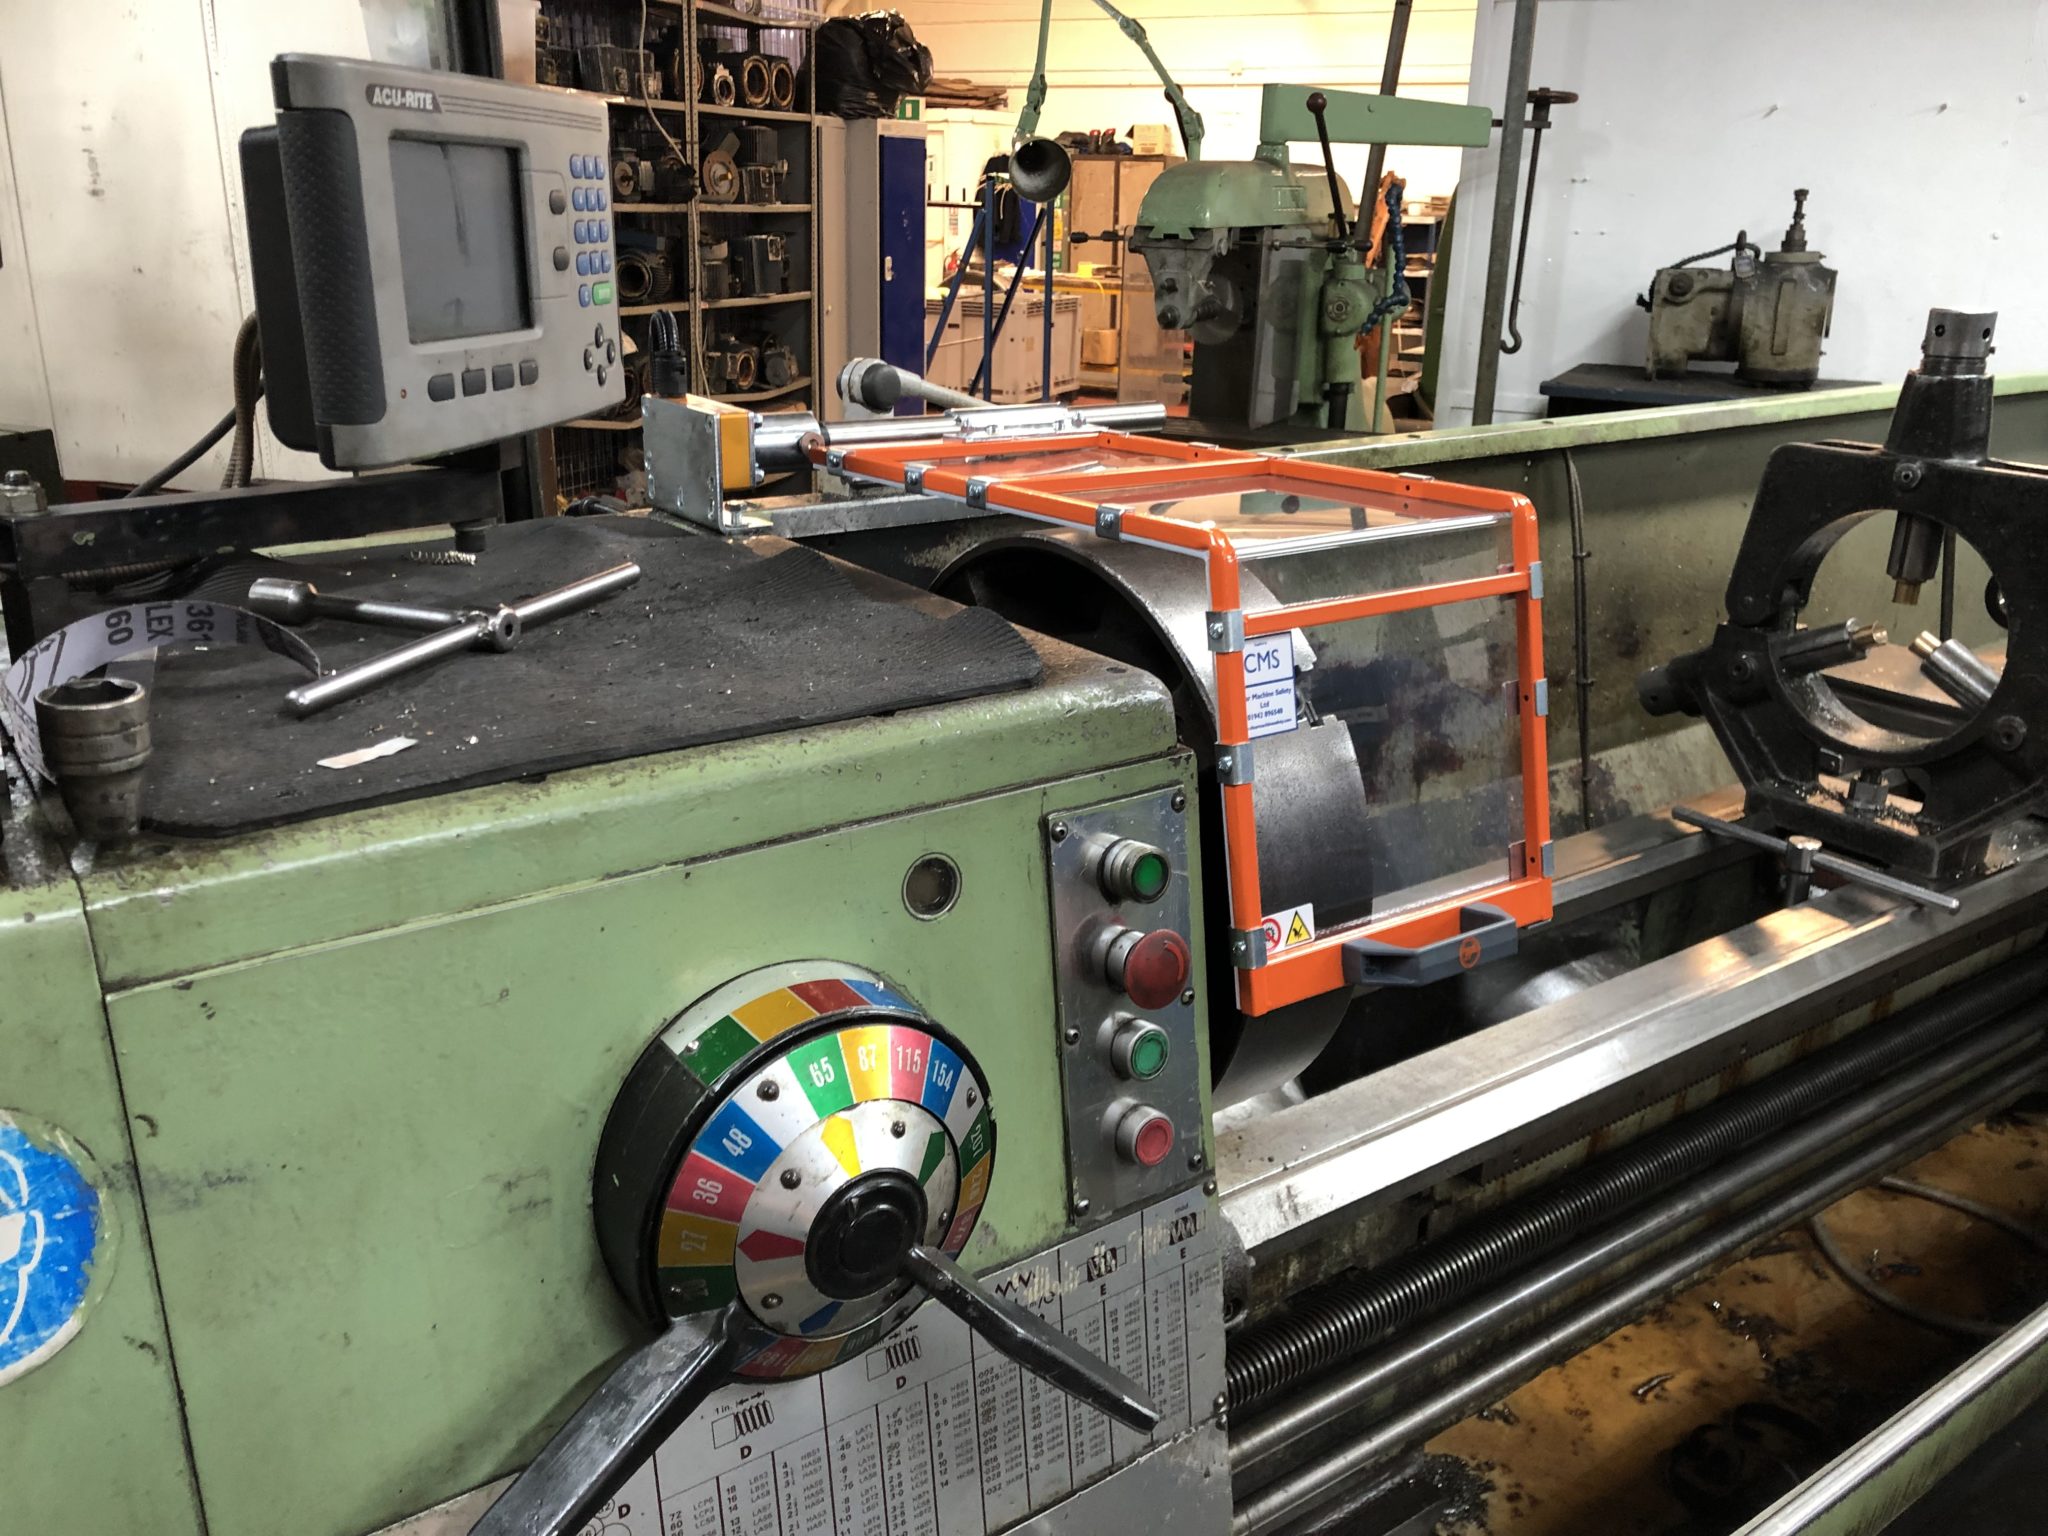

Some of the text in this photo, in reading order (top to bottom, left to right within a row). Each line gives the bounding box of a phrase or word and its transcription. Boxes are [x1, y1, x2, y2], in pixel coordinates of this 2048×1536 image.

[372, 86, 434, 110] ACU-RITE
[105, 610, 134, 646] 60
[1244, 649, 1281, 673] CMS
[858, 1044, 878, 1071] 87
[895, 1046, 921, 1074] 115
[809, 1057, 836, 1088] 65
[931, 1059, 952, 1093] 154
[721, 1128, 753, 1158] 48
[971, 1124, 984, 1157] 207
[692, 1178, 723, 1206] 36
[680, 1230, 709, 1253] 27
[1180, 1247, 1187, 1260] E
[1100, 1283, 1108, 1297] E
[895, 1375, 907, 1391] D
[740, 1445, 752, 1461] D
[617, 1503, 631, 1520] D
